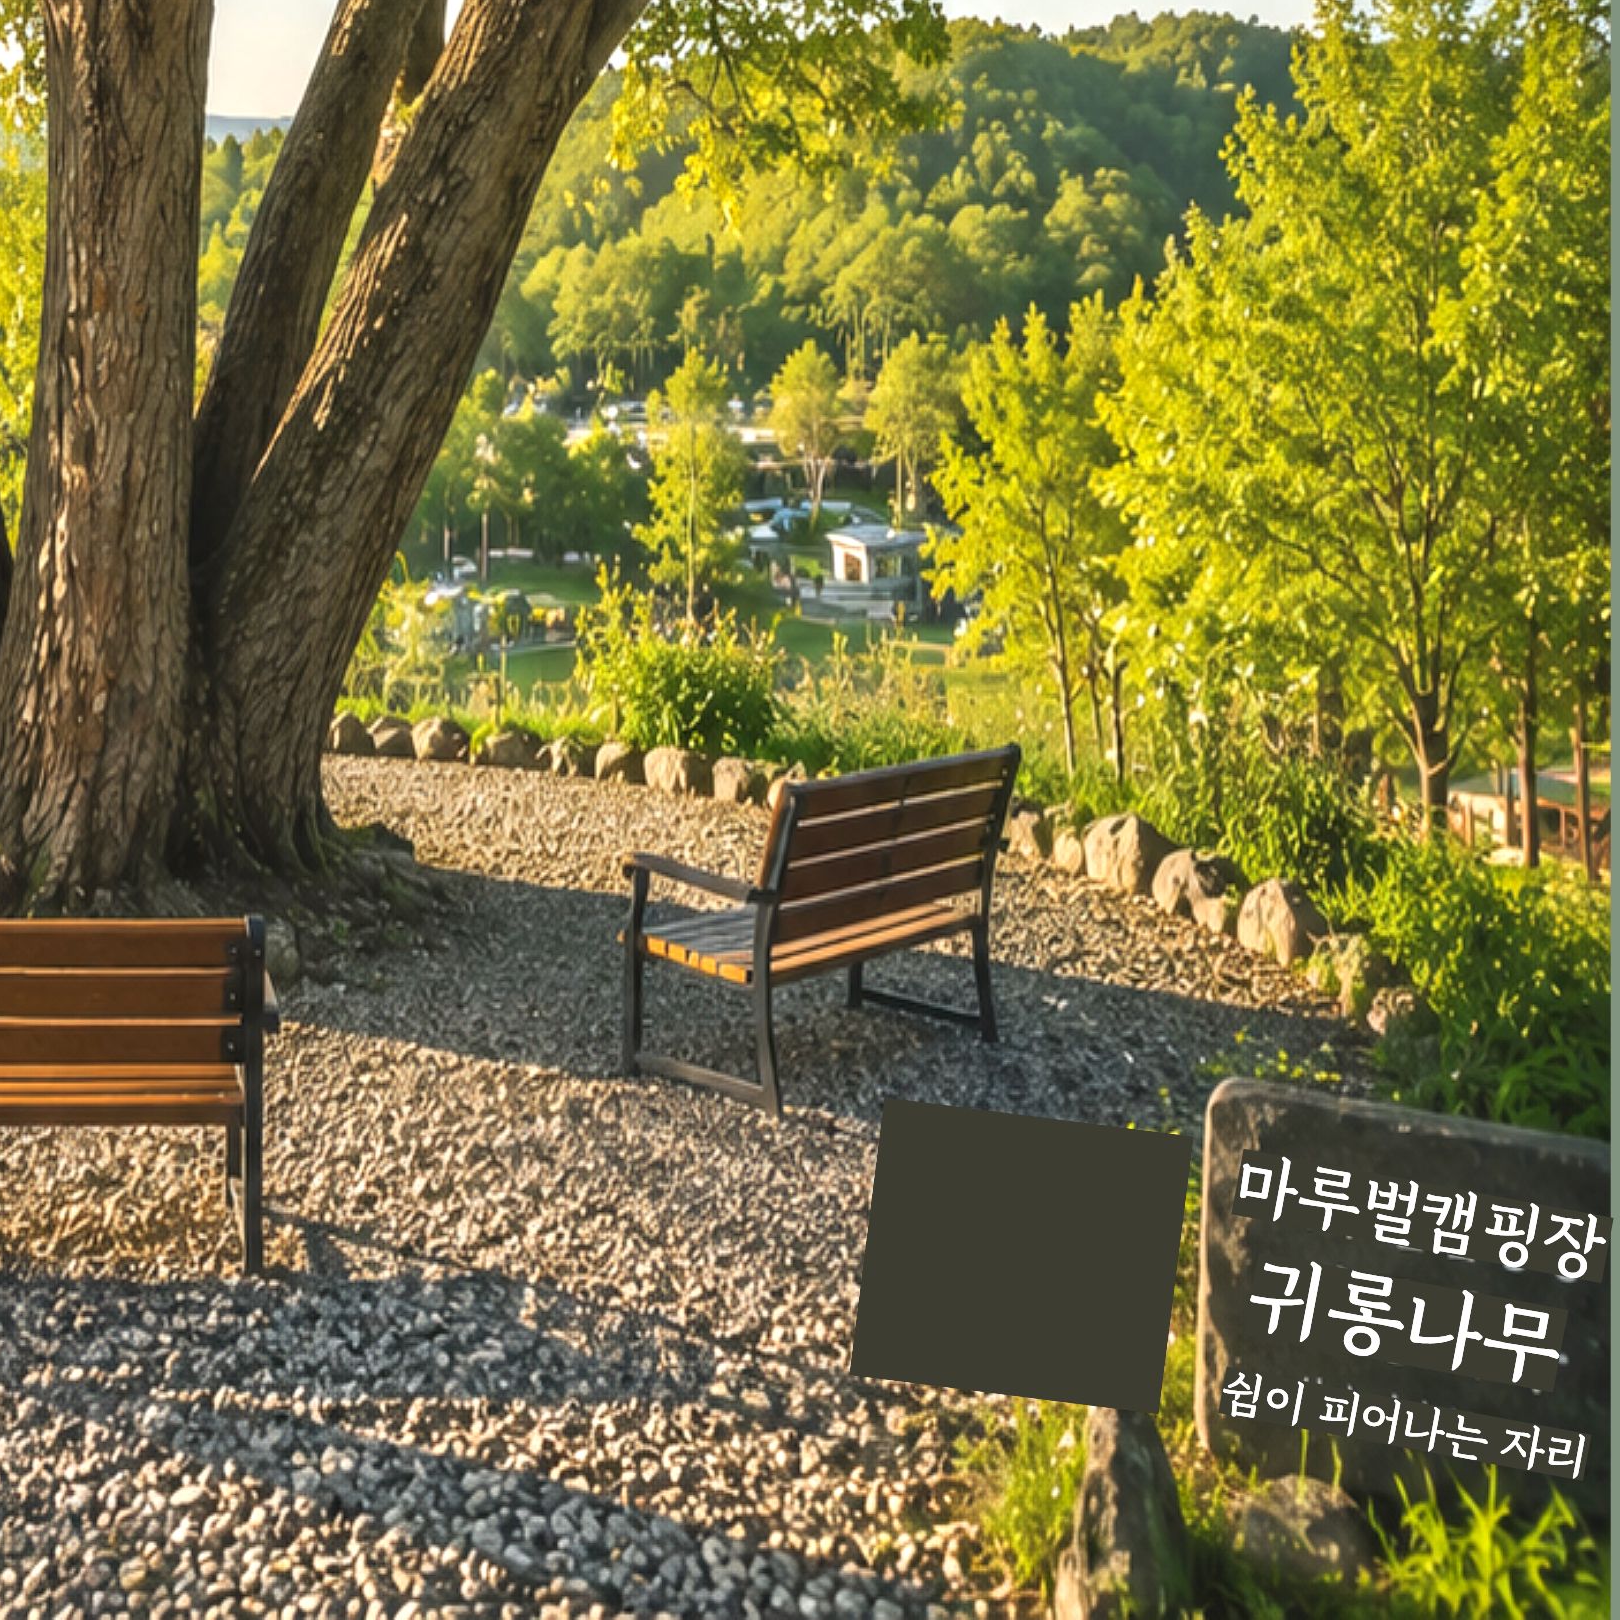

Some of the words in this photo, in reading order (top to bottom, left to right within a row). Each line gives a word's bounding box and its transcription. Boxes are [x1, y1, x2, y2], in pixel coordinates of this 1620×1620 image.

[1239, 1156, 1607, 1279] 마루벌캠핑장
[1250, 1262, 1560, 1383] 귀롱나무
[1222, 1372, 1305, 1426] 쉼이
[1319, 1392, 1489, 1461] 피어나는
[1500, 1425, 1586, 1479] 자리
